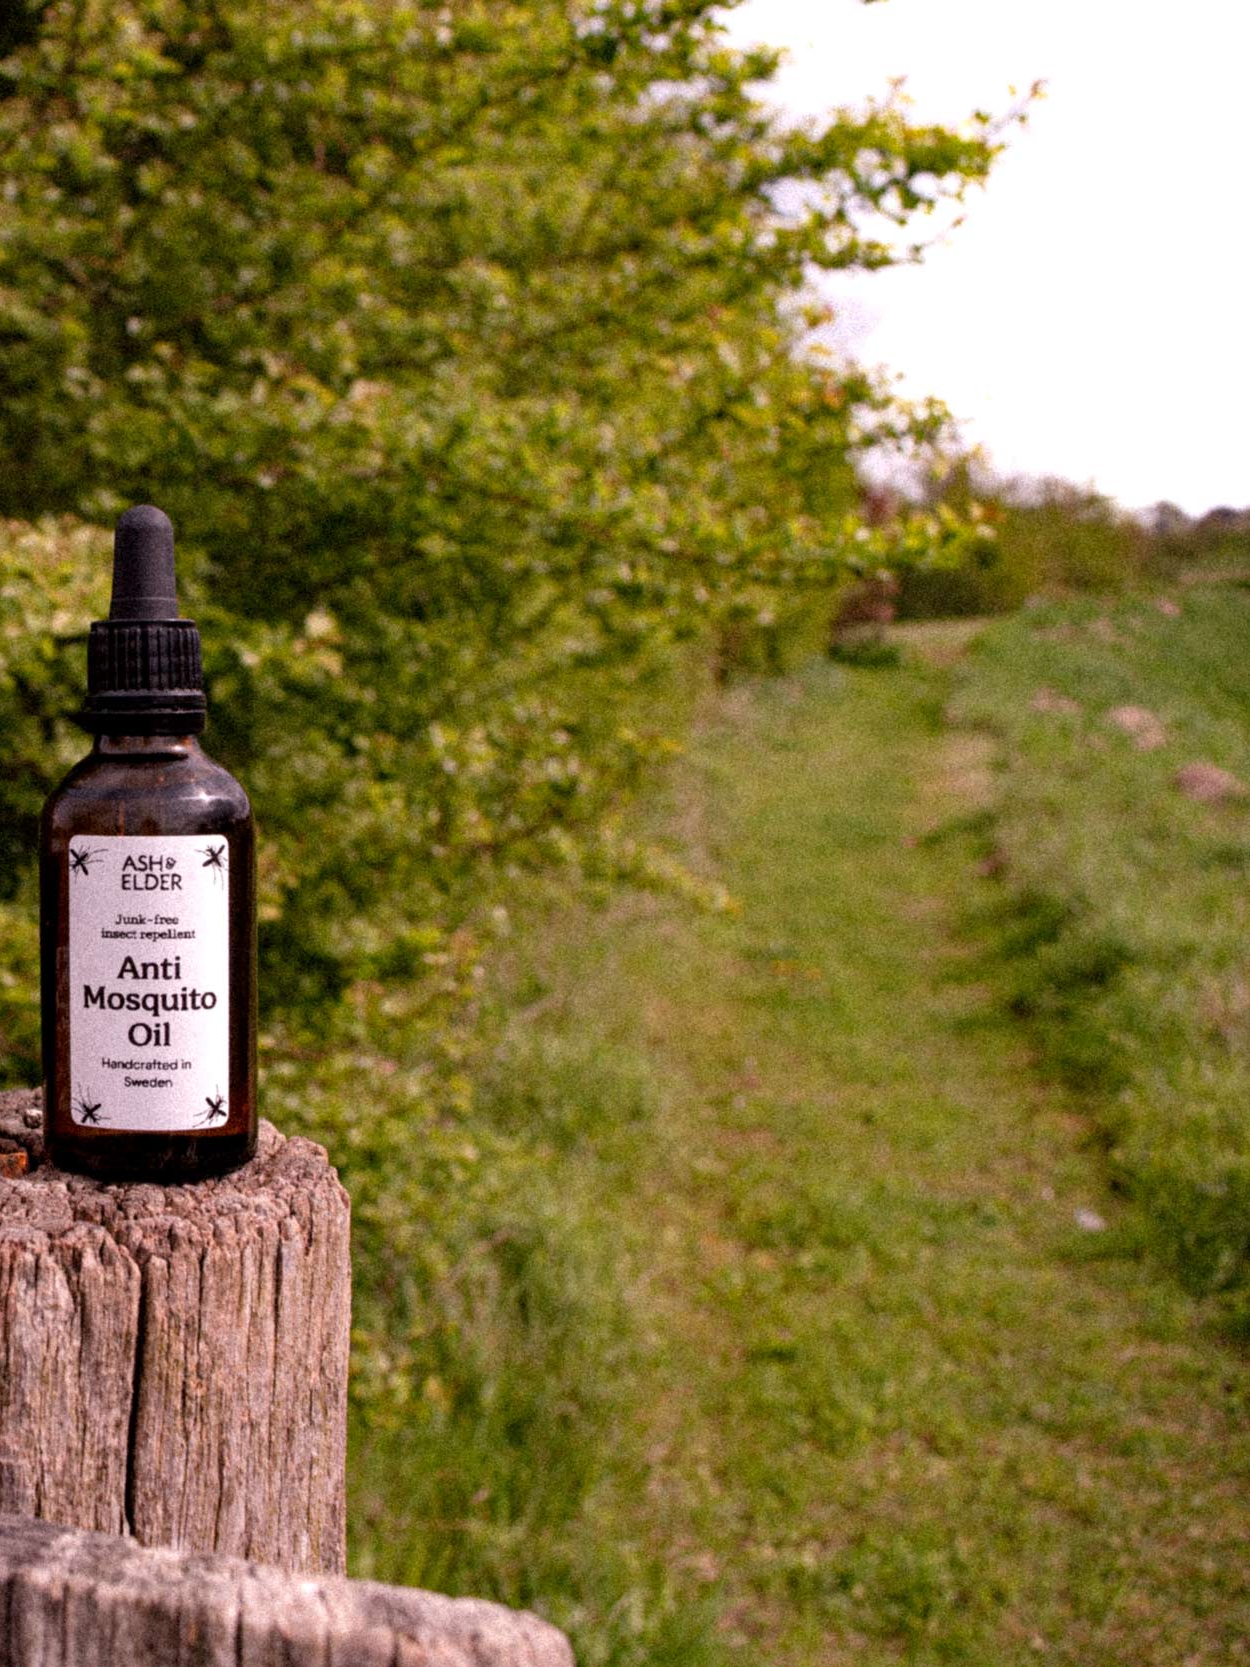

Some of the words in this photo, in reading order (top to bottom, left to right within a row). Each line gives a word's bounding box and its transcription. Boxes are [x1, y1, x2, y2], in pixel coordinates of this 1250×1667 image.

[121, 874, 182, 891] ELDER
[101, 928, 137, 939] insect
[140, 928, 196, 942] repellent
[117, 955, 181, 980] Anti
[83, 985, 217, 1017] Mosquito
[128, 1021, 171, 1047] Oil
[101, 1057, 178, 1071] Handcrafted
[181, 1059, 192, 1070] in
[124, 1076, 173, 1088] Sweden
